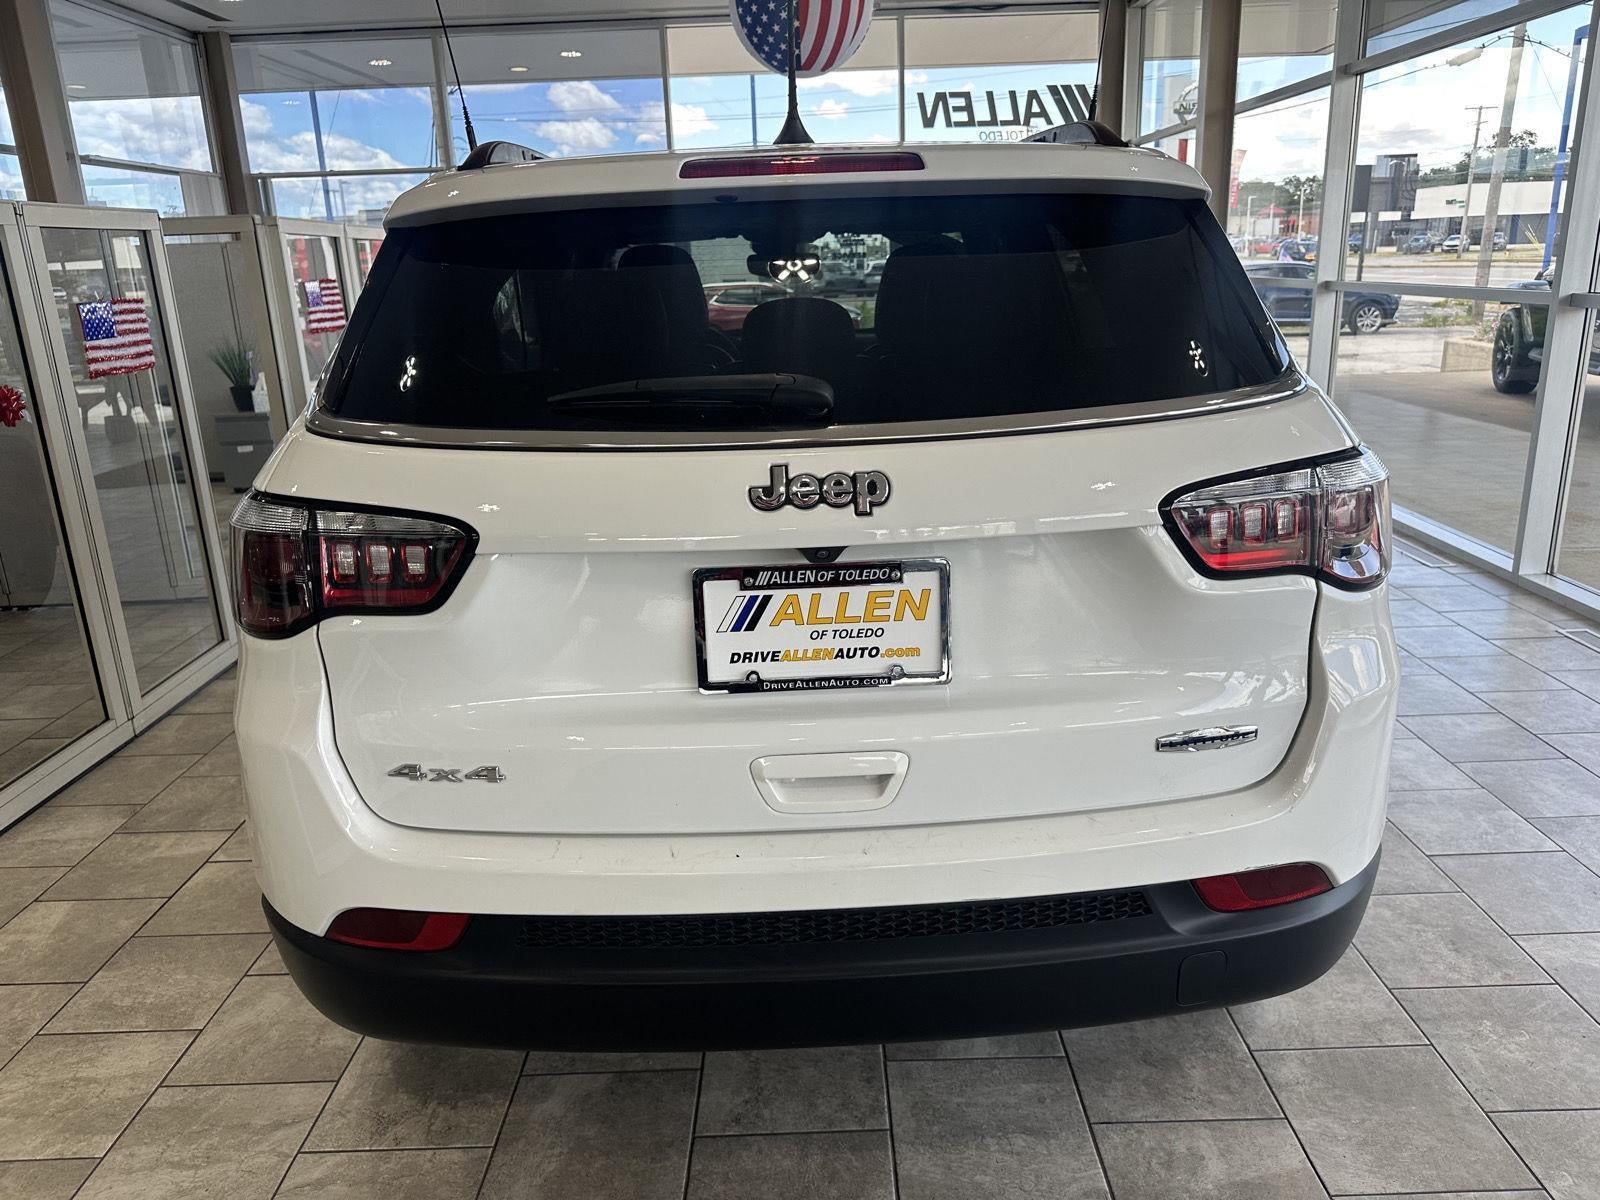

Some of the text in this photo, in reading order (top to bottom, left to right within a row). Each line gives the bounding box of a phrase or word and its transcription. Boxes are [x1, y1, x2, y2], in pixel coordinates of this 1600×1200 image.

[749, 464, 891, 516] Jeep
[770, 568, 889, 584] ALLEN OF TOLEDO
[769, 588, 931, 627] ALLEN
[809, 627, 885, 640] OF TOLEDO
[729, 645, 920, 664] DRIVEALLENAUTO.com
